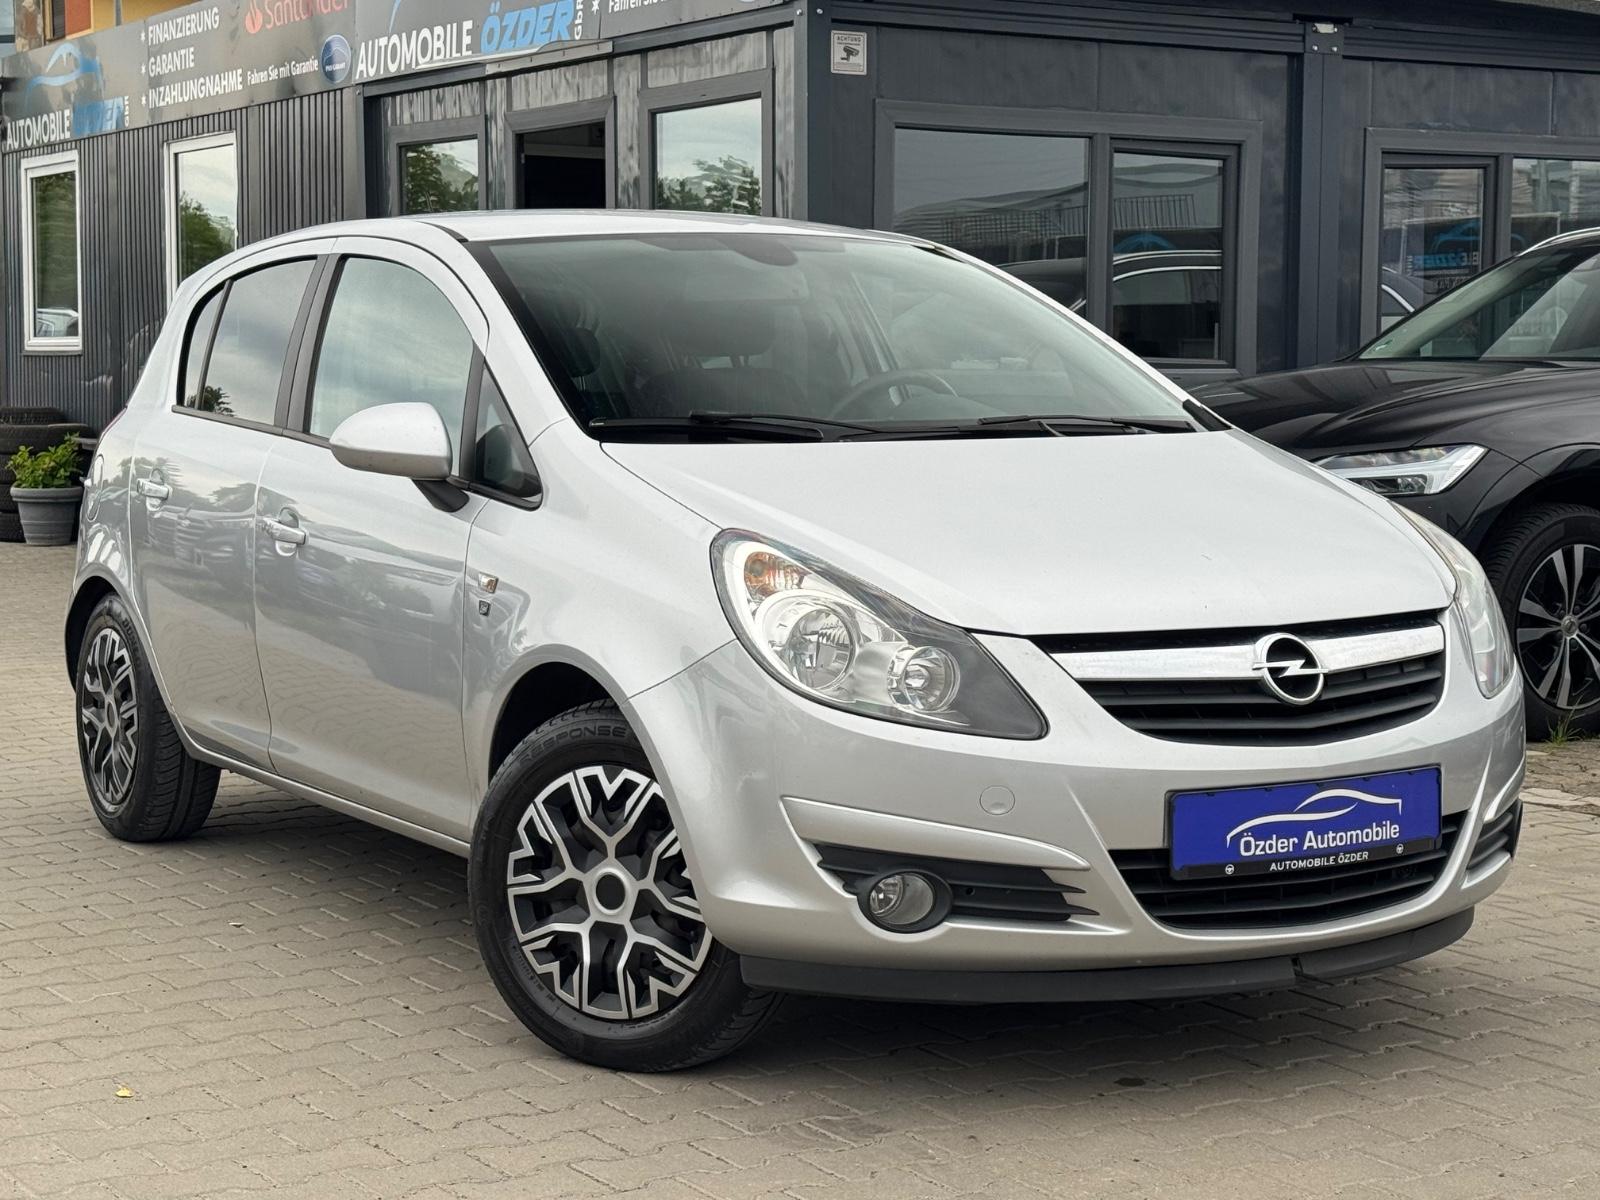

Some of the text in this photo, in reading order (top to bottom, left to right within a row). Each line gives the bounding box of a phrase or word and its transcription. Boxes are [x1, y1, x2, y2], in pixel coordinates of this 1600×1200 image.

[148, 6, 220, 46] FINANZIERUNG
[356, 20, 472, 79] AUTOMOBILE
[481, 0, 573, 53] ÖZDER
[148, 46, 195, 77] GARANTIE
[247, 55, 319, 86] Fahren Sie mit Garantie
[148, 68, 243, 109] INZAHLUNGNAHME
[6, 108, 71, 151] AUTOMOBILE
[1240, 821, 1399, 856] Özder Automobile
[1270, 851, 1369, 871] AUTOMOBILE ÖZDER
